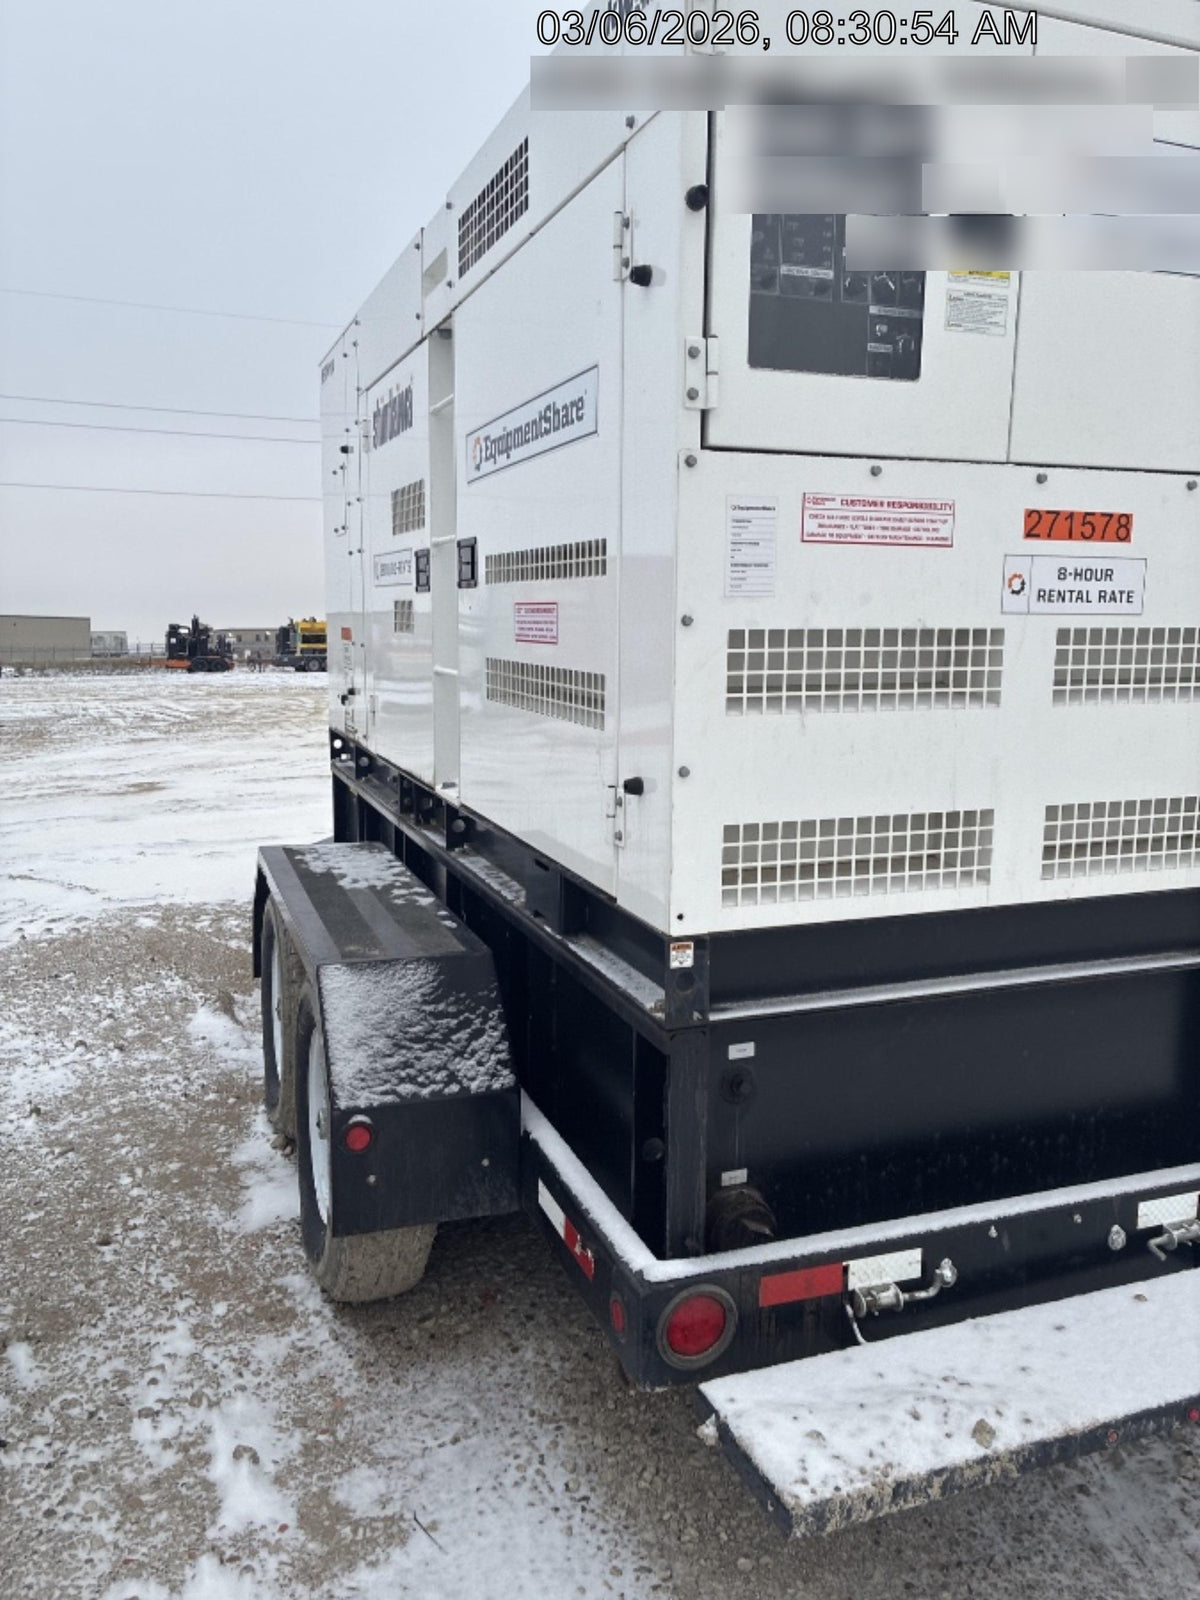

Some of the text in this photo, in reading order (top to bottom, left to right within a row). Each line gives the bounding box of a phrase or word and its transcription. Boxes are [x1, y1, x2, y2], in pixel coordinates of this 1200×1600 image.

[484, 396, 585, 464] EquipmentShare
[1025, 510, 1131, 541] 271578
[1057, 566, 1114, 582] 8-HOUR
[1037, 588, 1135, 604] RENTAL RATE
